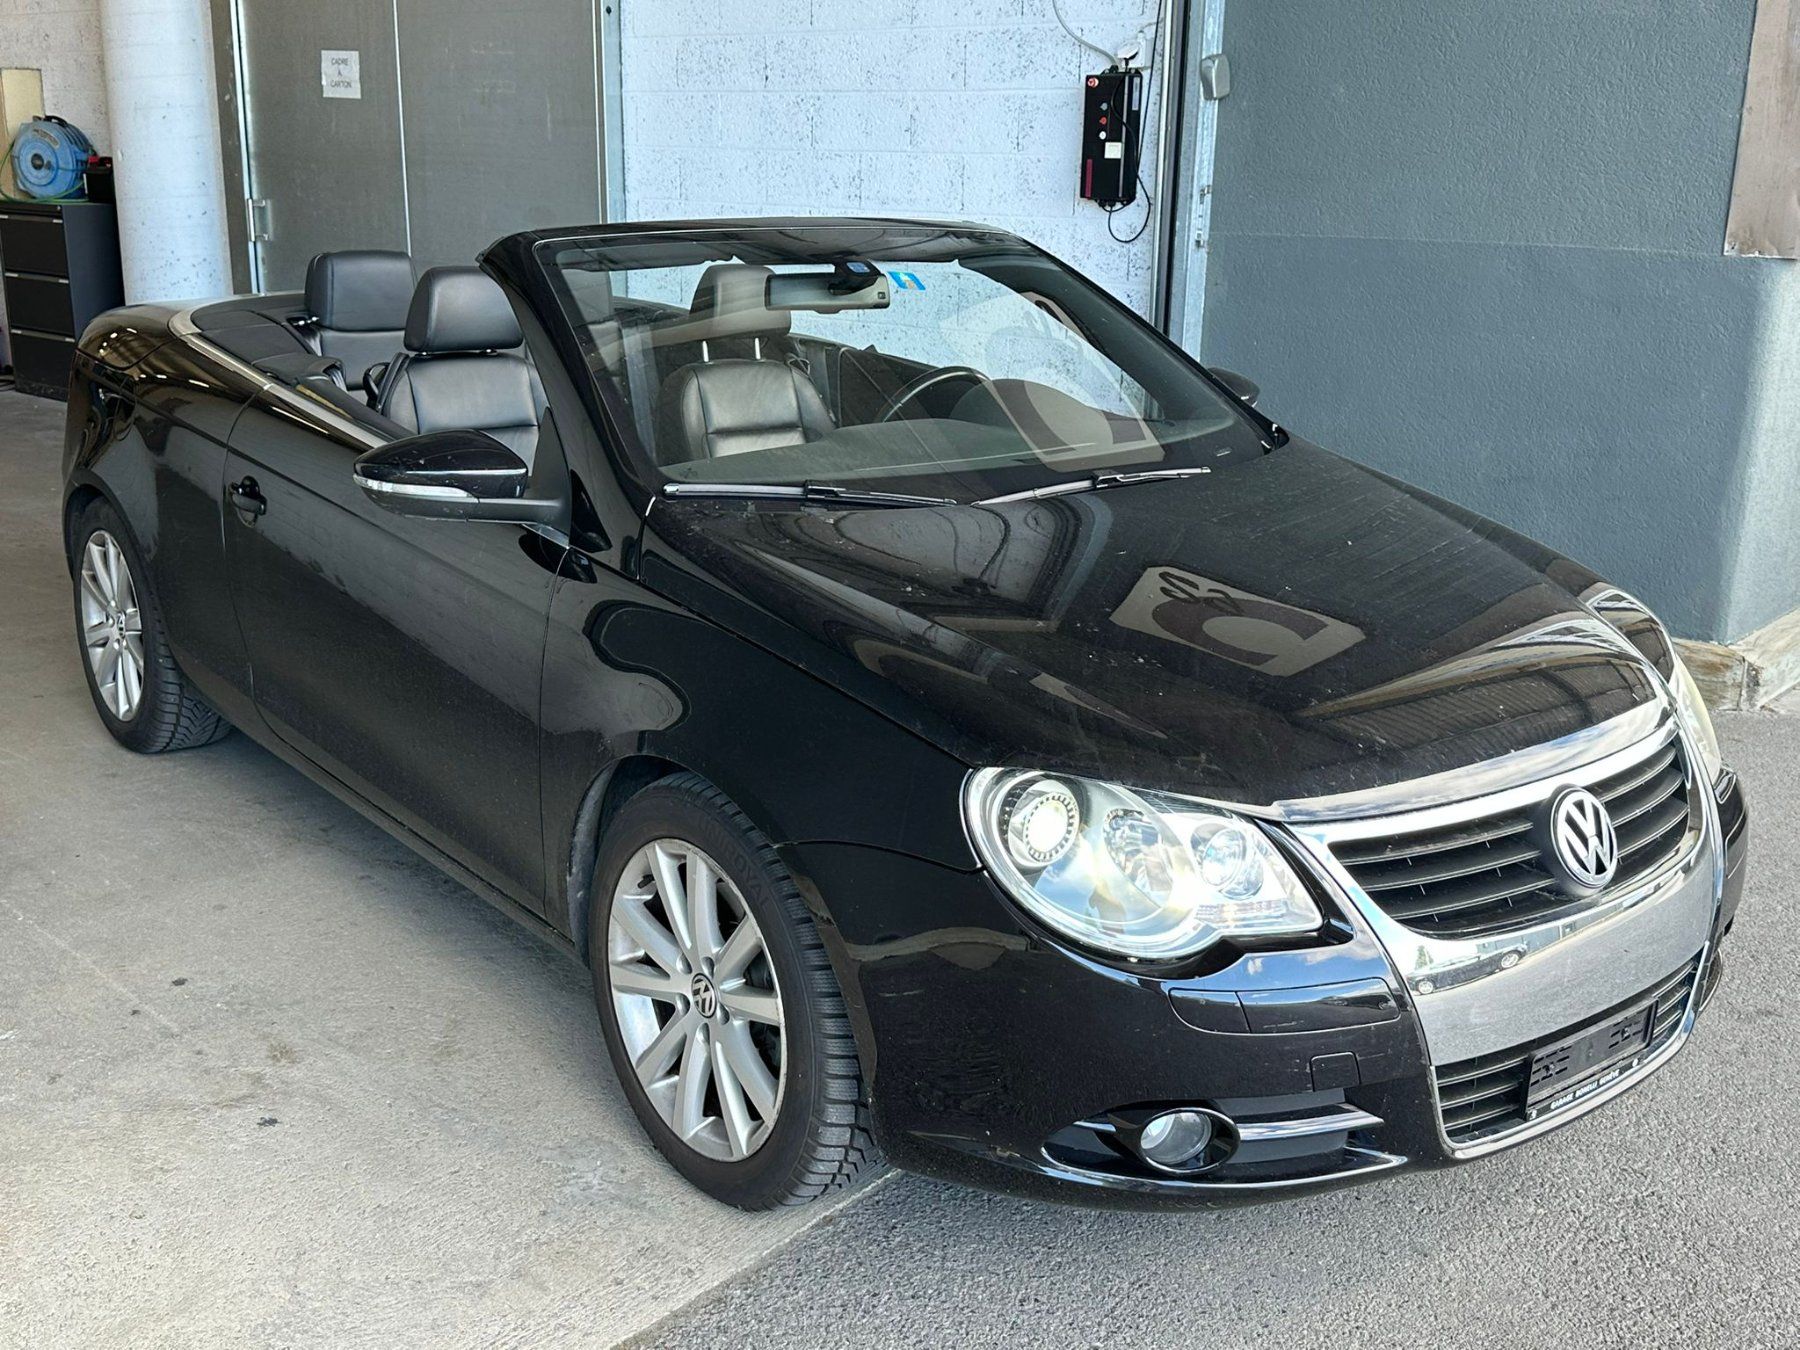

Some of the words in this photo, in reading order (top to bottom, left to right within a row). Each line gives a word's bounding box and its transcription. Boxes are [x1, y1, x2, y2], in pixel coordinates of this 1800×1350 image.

[330, 79, 352, 88] CARTON
[331, 57, 349, 66] CADRE
[1554, 790, 1616, 884] VW
[697, 815, 770, 914] UNIROYAL
